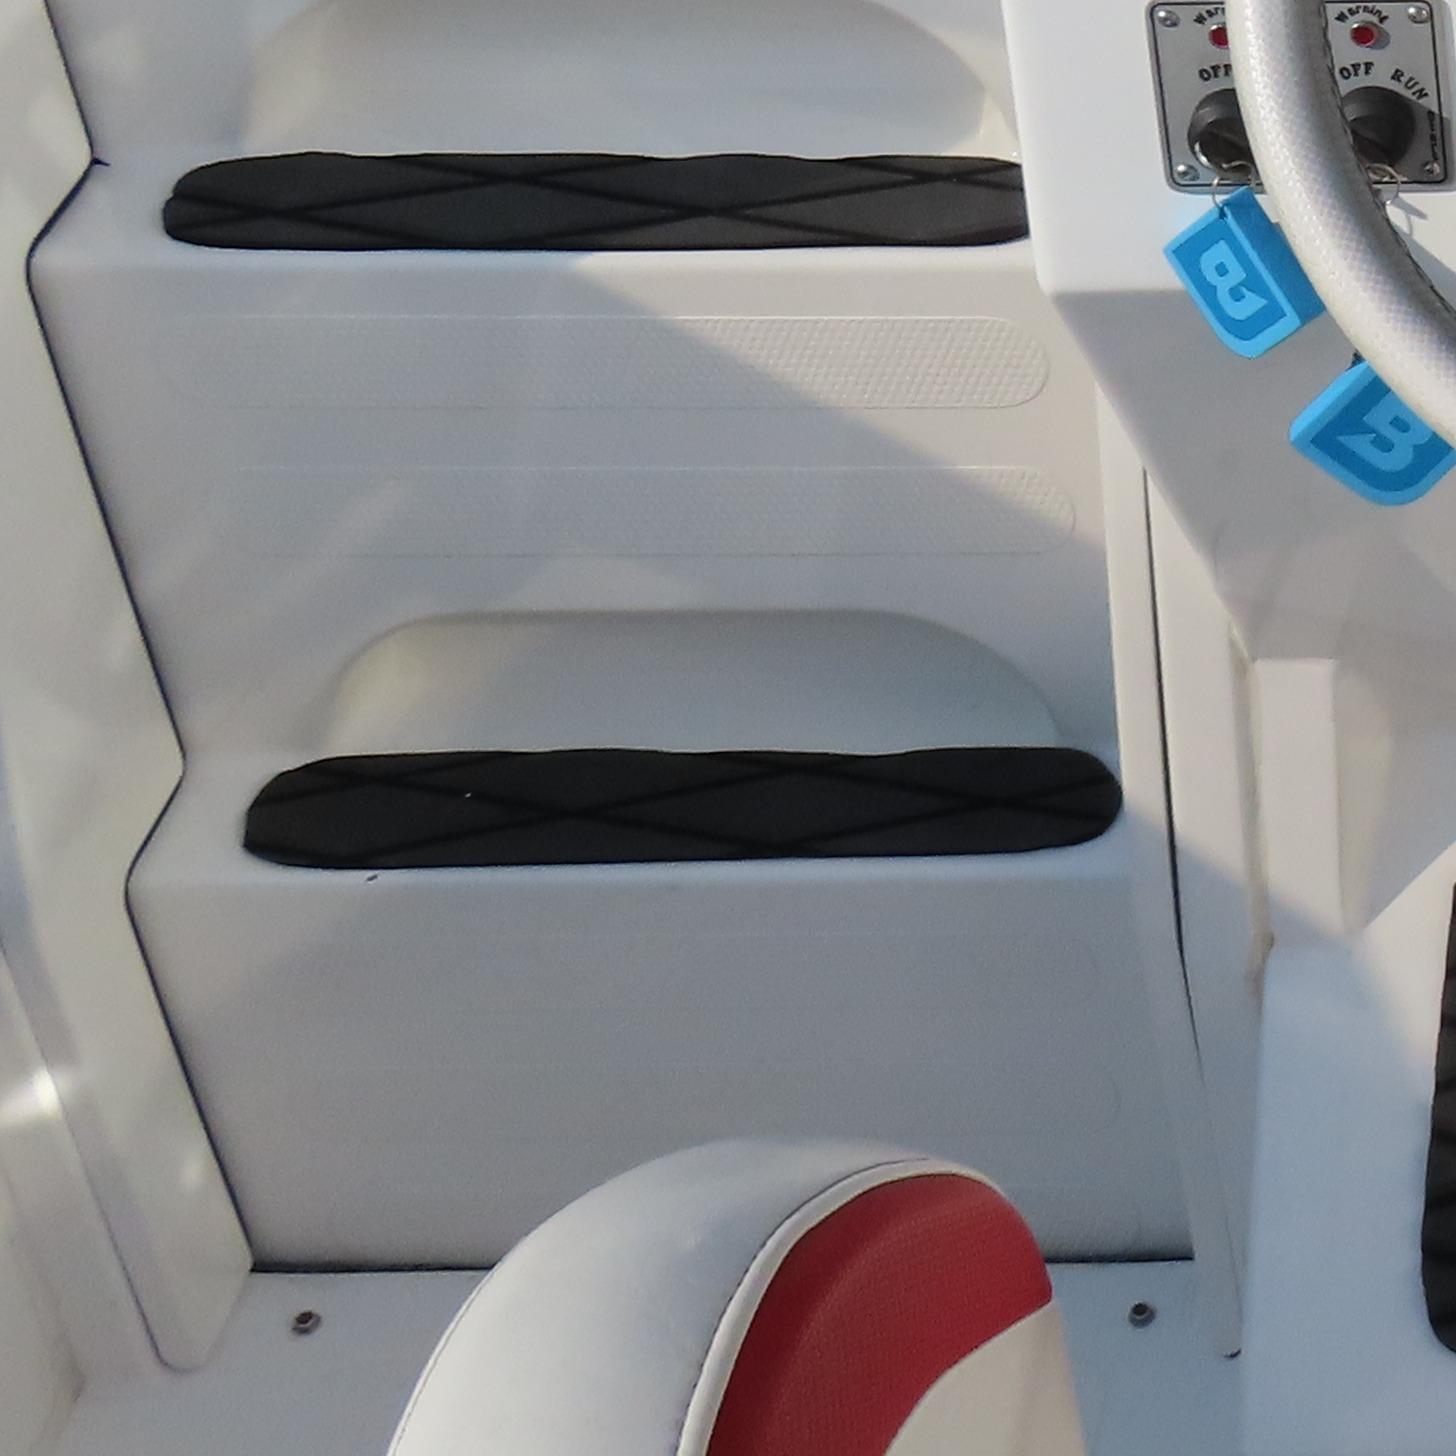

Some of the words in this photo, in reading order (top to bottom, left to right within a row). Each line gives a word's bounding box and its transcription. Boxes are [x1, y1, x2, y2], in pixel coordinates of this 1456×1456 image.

[1335, 5, 1390, 25] Warning
[1198, 64, 1233, 82] OFF
[1339, 62, 1374, 80] OFF
[1390, 69, 1429, 101] RUN
